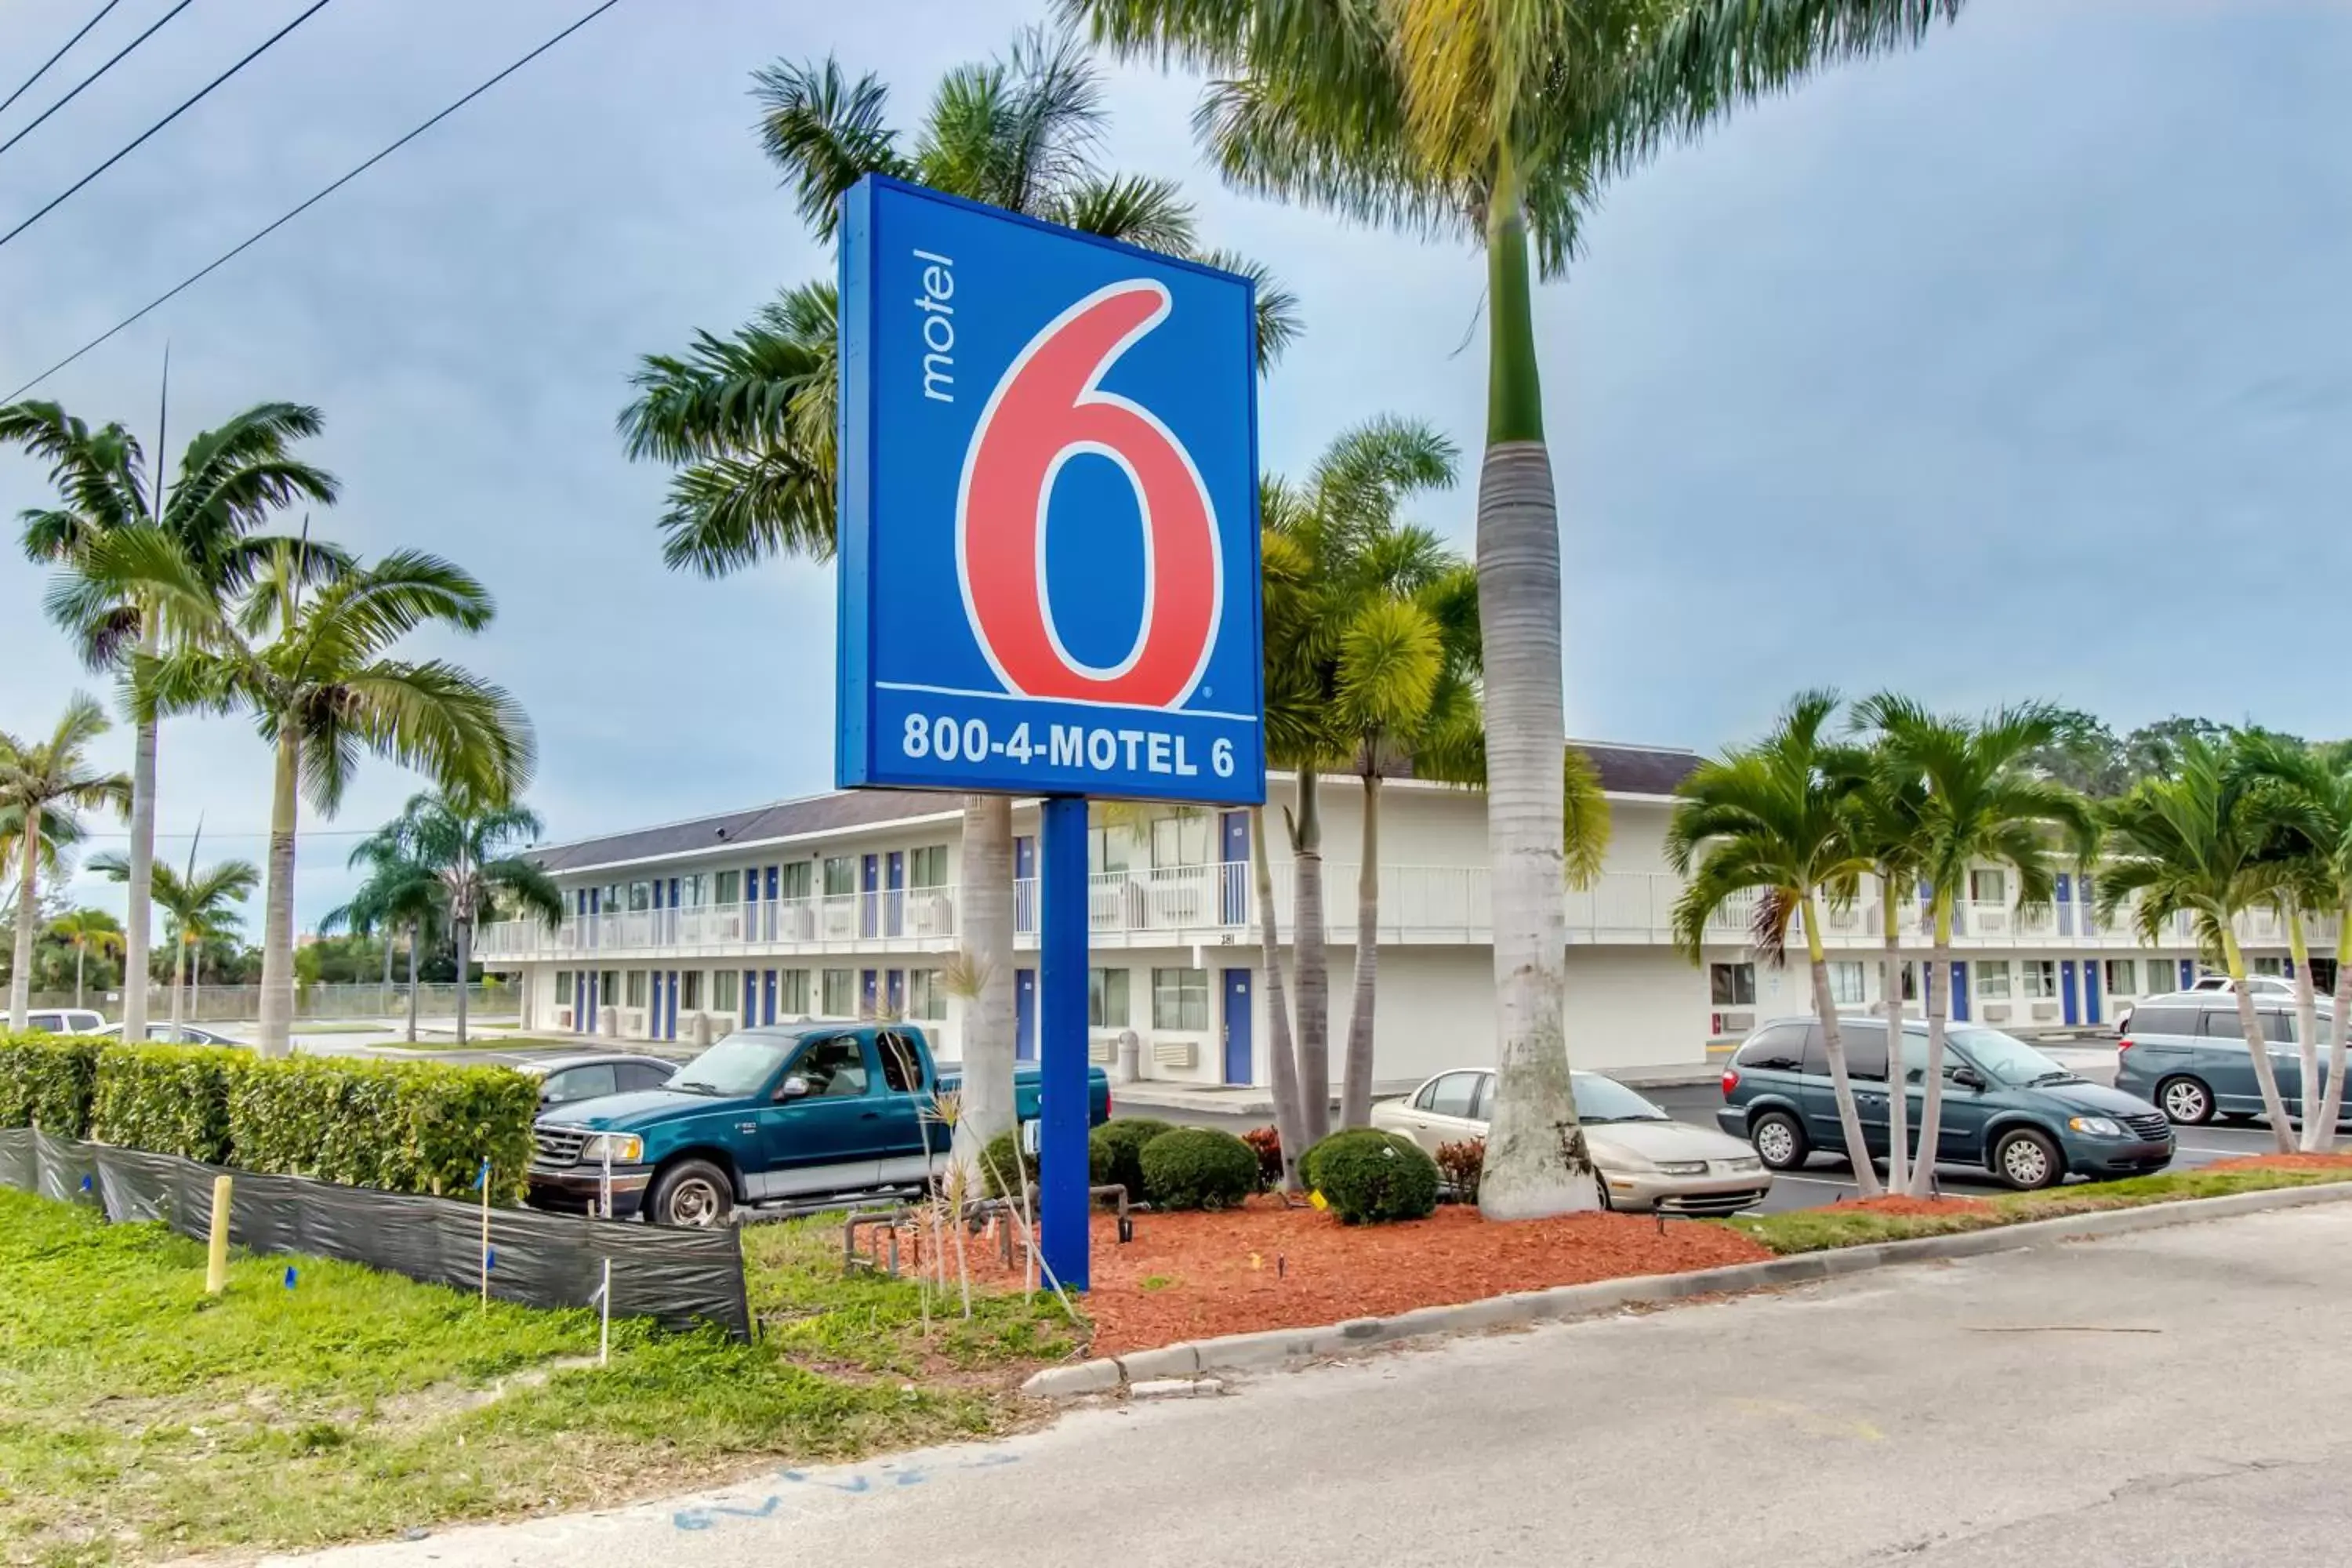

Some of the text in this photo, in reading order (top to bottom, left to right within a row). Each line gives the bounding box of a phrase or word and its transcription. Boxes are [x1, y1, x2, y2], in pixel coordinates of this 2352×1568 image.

[913, 249, 954, 402] motel
[955, 278, 1224, 710] 6
[902, 713, 1235, 778] 800-4-MOTEL 6
